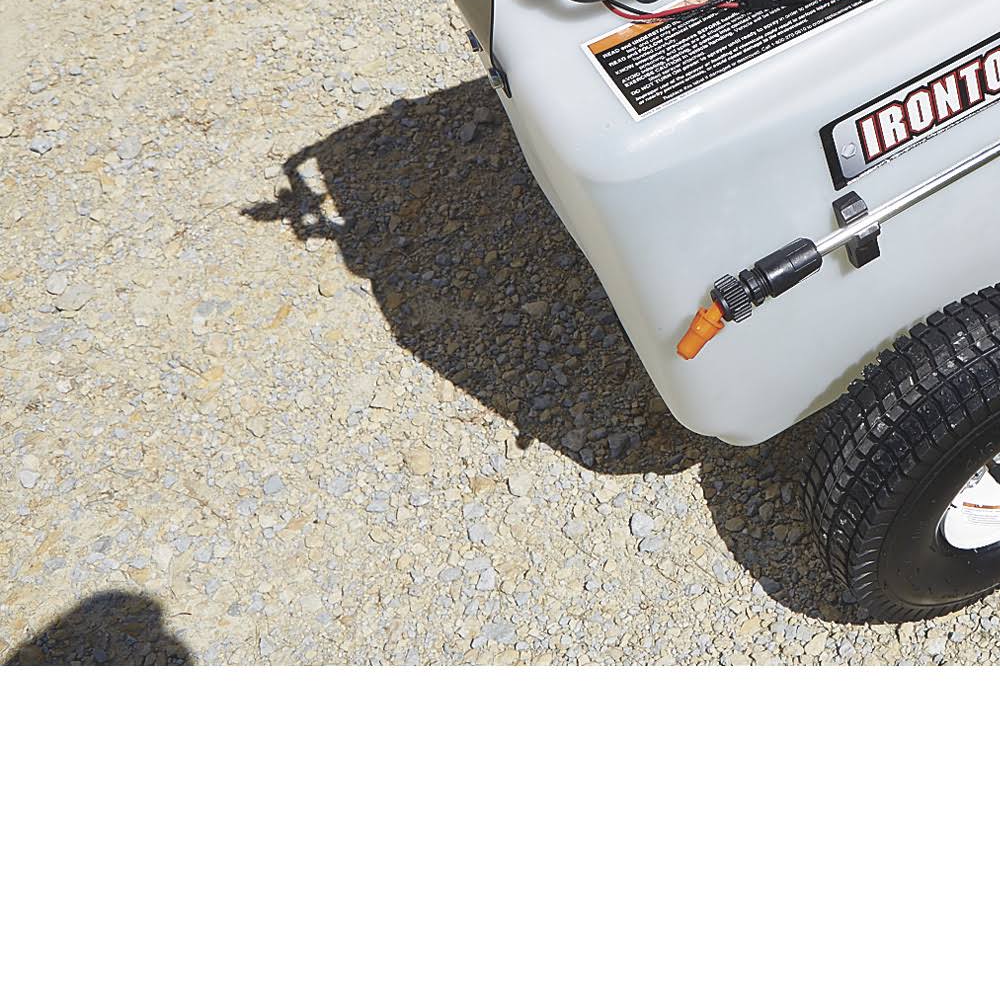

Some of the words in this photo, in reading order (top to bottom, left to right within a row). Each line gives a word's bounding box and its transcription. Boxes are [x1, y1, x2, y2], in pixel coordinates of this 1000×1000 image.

[697, 21, 721, 34] BEFORE
[638, 39, 663, 53] FOLLOW
[655, 57, 681, 72] CAUTION
[641, 82, 654, 90] NOT
[654, 73, 672, 83] TURN
